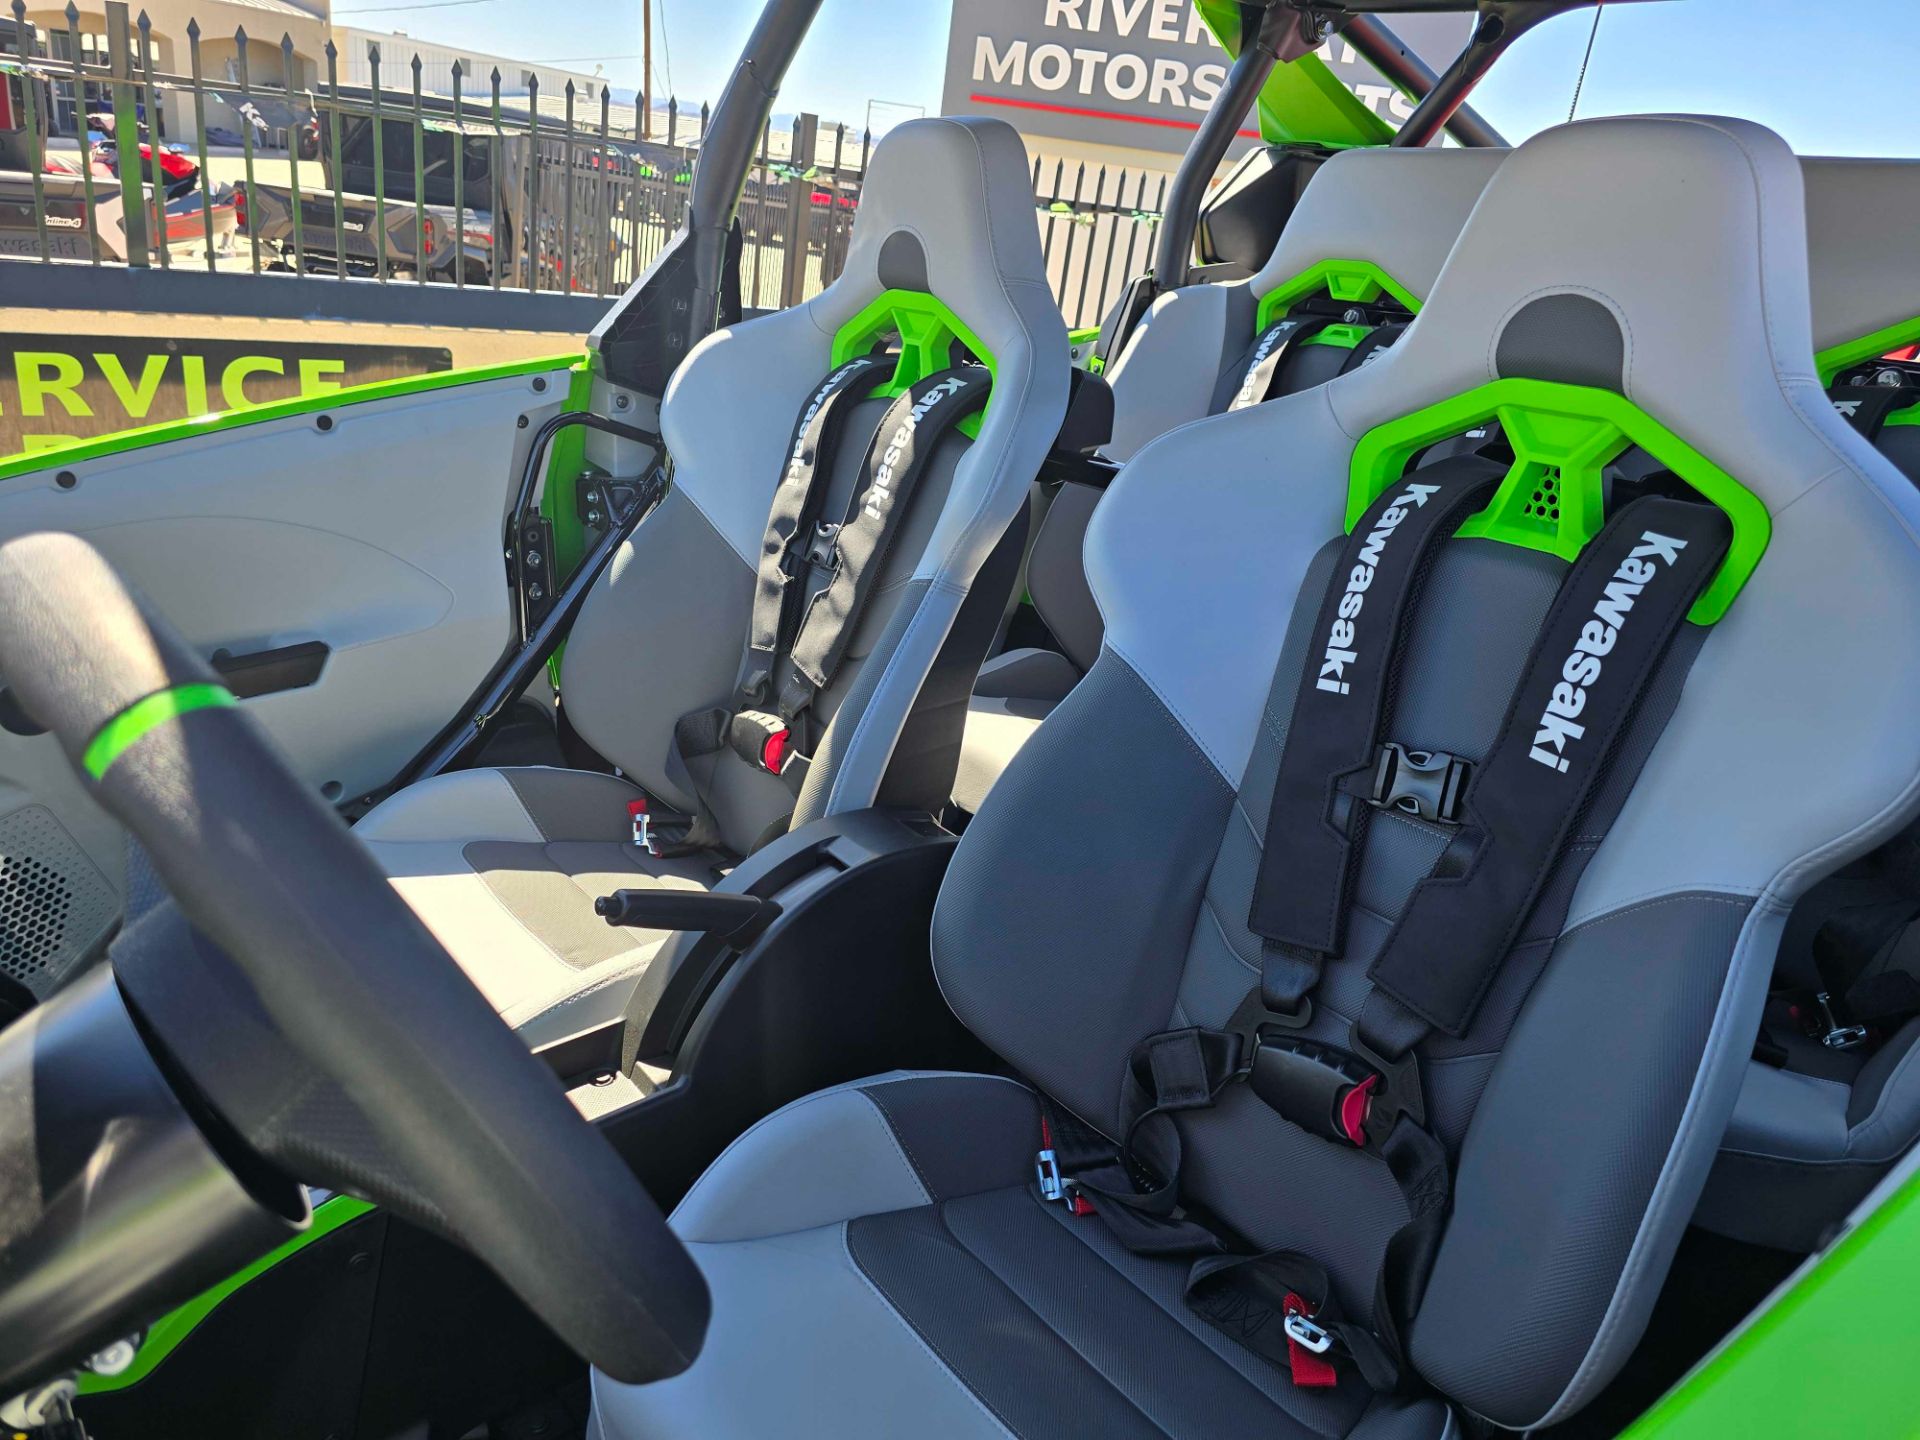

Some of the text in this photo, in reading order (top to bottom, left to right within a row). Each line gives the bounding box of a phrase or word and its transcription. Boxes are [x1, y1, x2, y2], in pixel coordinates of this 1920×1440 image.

[0, 351, 346, 418] RVICE
[785, 359, 872, 486] Kawasaki
[1236, 321, 1297, 408] Kawasa
[864, 377, 968, 520] Kawasaki
[1316, 482, 1441, 695] Kawasaki
[1529, 530, 1688, 773] Kawasaki
